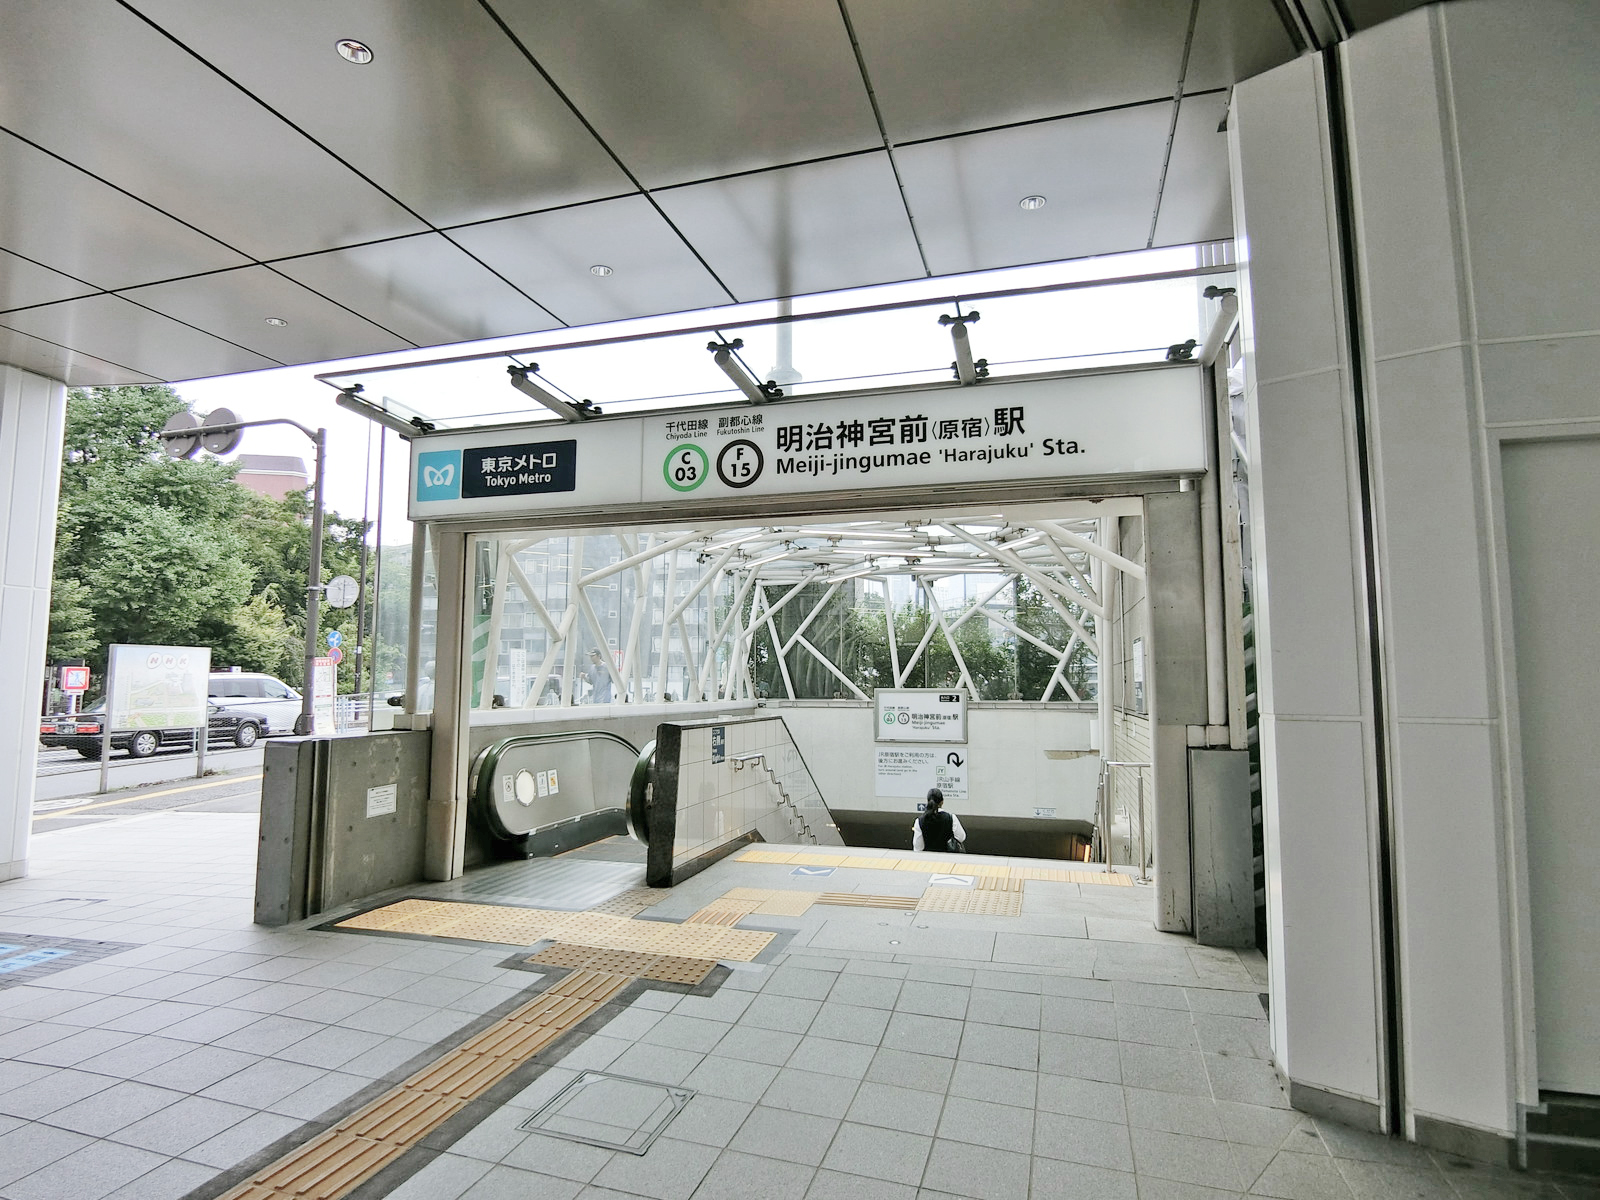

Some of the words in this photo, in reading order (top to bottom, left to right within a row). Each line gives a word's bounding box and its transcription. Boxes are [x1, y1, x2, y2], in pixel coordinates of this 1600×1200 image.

[665, 418, 709, 432] 千代田線
[718, 414, 763, 429] 副都心線
[666, 431, 692, 441] Chiyoda
[693, 430, 708, 438] Line
[716, 427, 750, 436] Fukutoshin
[751, 425, 765, 433] Line
[681, 451, 691, 465] C
[736, 447, 744, 461] F
[776, 448, 931, 476] Meiji-jingumae
[938, 443, 1034, 464] 'Harajuku'
[1042, 438, 1086, 456] Sta.
[480, 452, 557, 474] 東京メトロ
[731, 462, 751, 477] 15
[485, 474, 516, 488] Tokyo
[518, 472, 551, 485] Metro
[674, 466, 697, 481] 03
